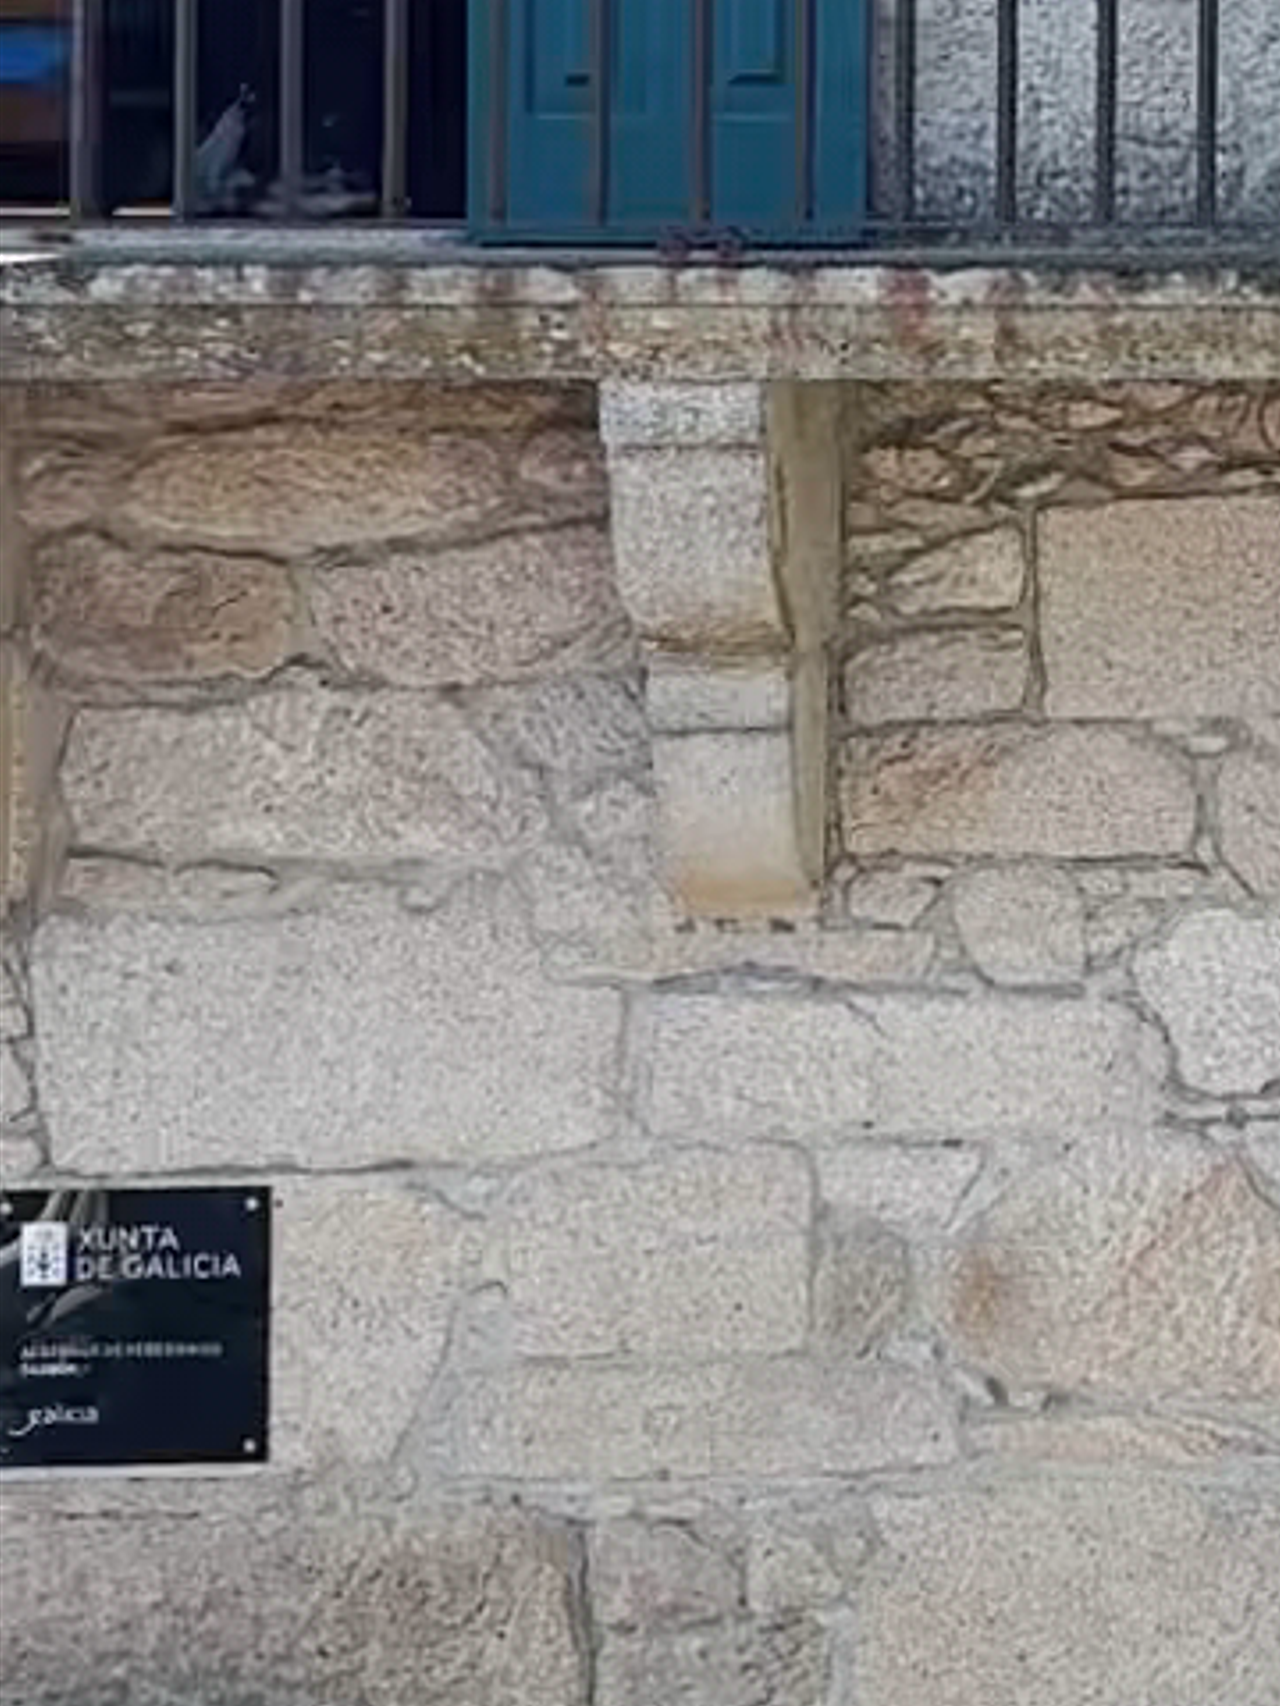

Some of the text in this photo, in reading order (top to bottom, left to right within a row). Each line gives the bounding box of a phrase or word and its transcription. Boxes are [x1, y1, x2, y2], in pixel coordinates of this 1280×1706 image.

[79, 1225, 179, 1251] XUNTA
[76, 1252, 241, 1279] DE GALICIA
